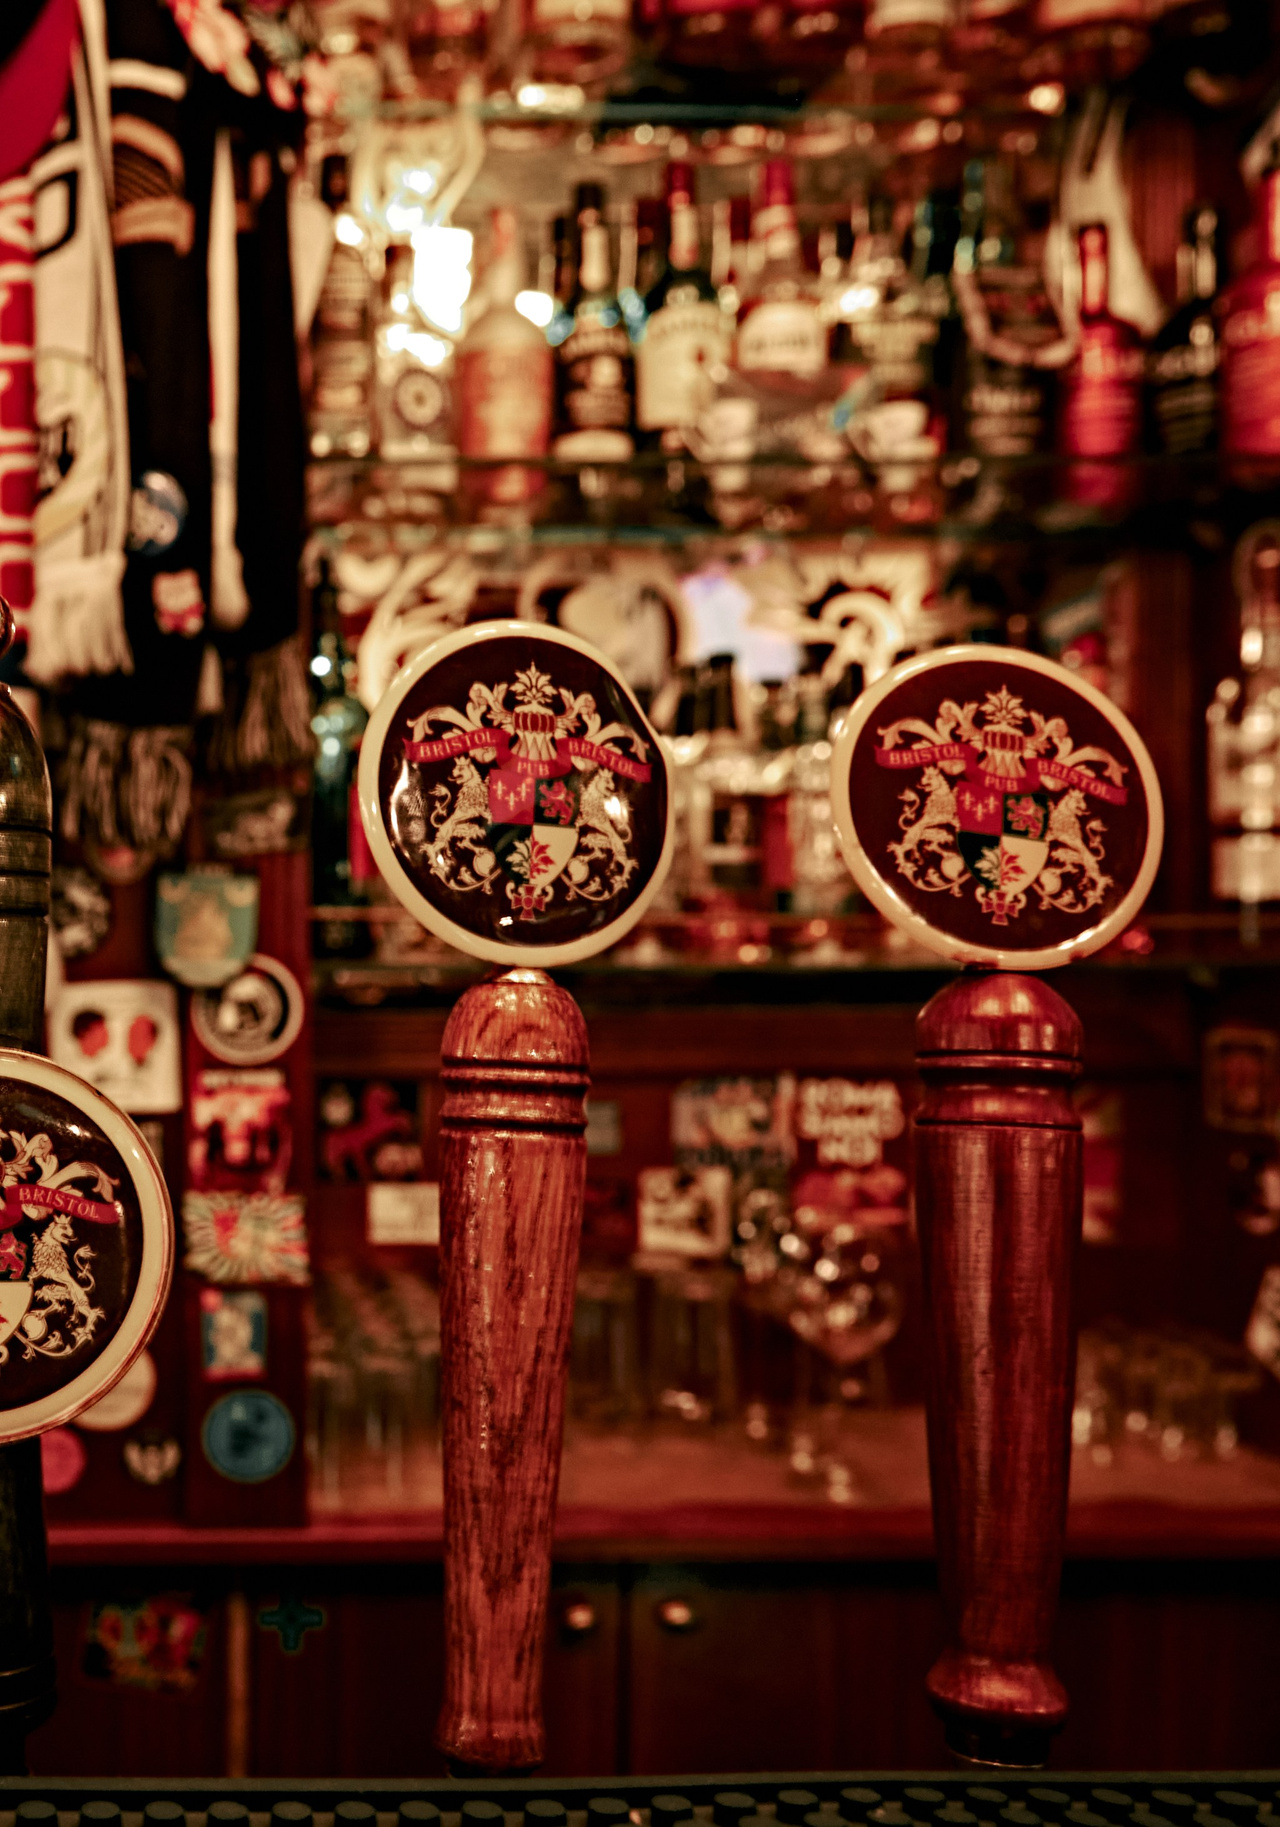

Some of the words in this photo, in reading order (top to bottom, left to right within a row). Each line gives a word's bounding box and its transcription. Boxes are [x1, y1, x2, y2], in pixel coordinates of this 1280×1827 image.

[421, 735, 496, 758] BRISTOL
[517, 763, 550, 776] PUB
[570, 742, 637, 777] BRISTOL
[889, 744, 966, 766] BRISTOL
[984, 776, 1019, 792] PUB
[1037, 760, 1111, 800] BRISTOL
[19, 1188, 100, 1218] BRISTOL
